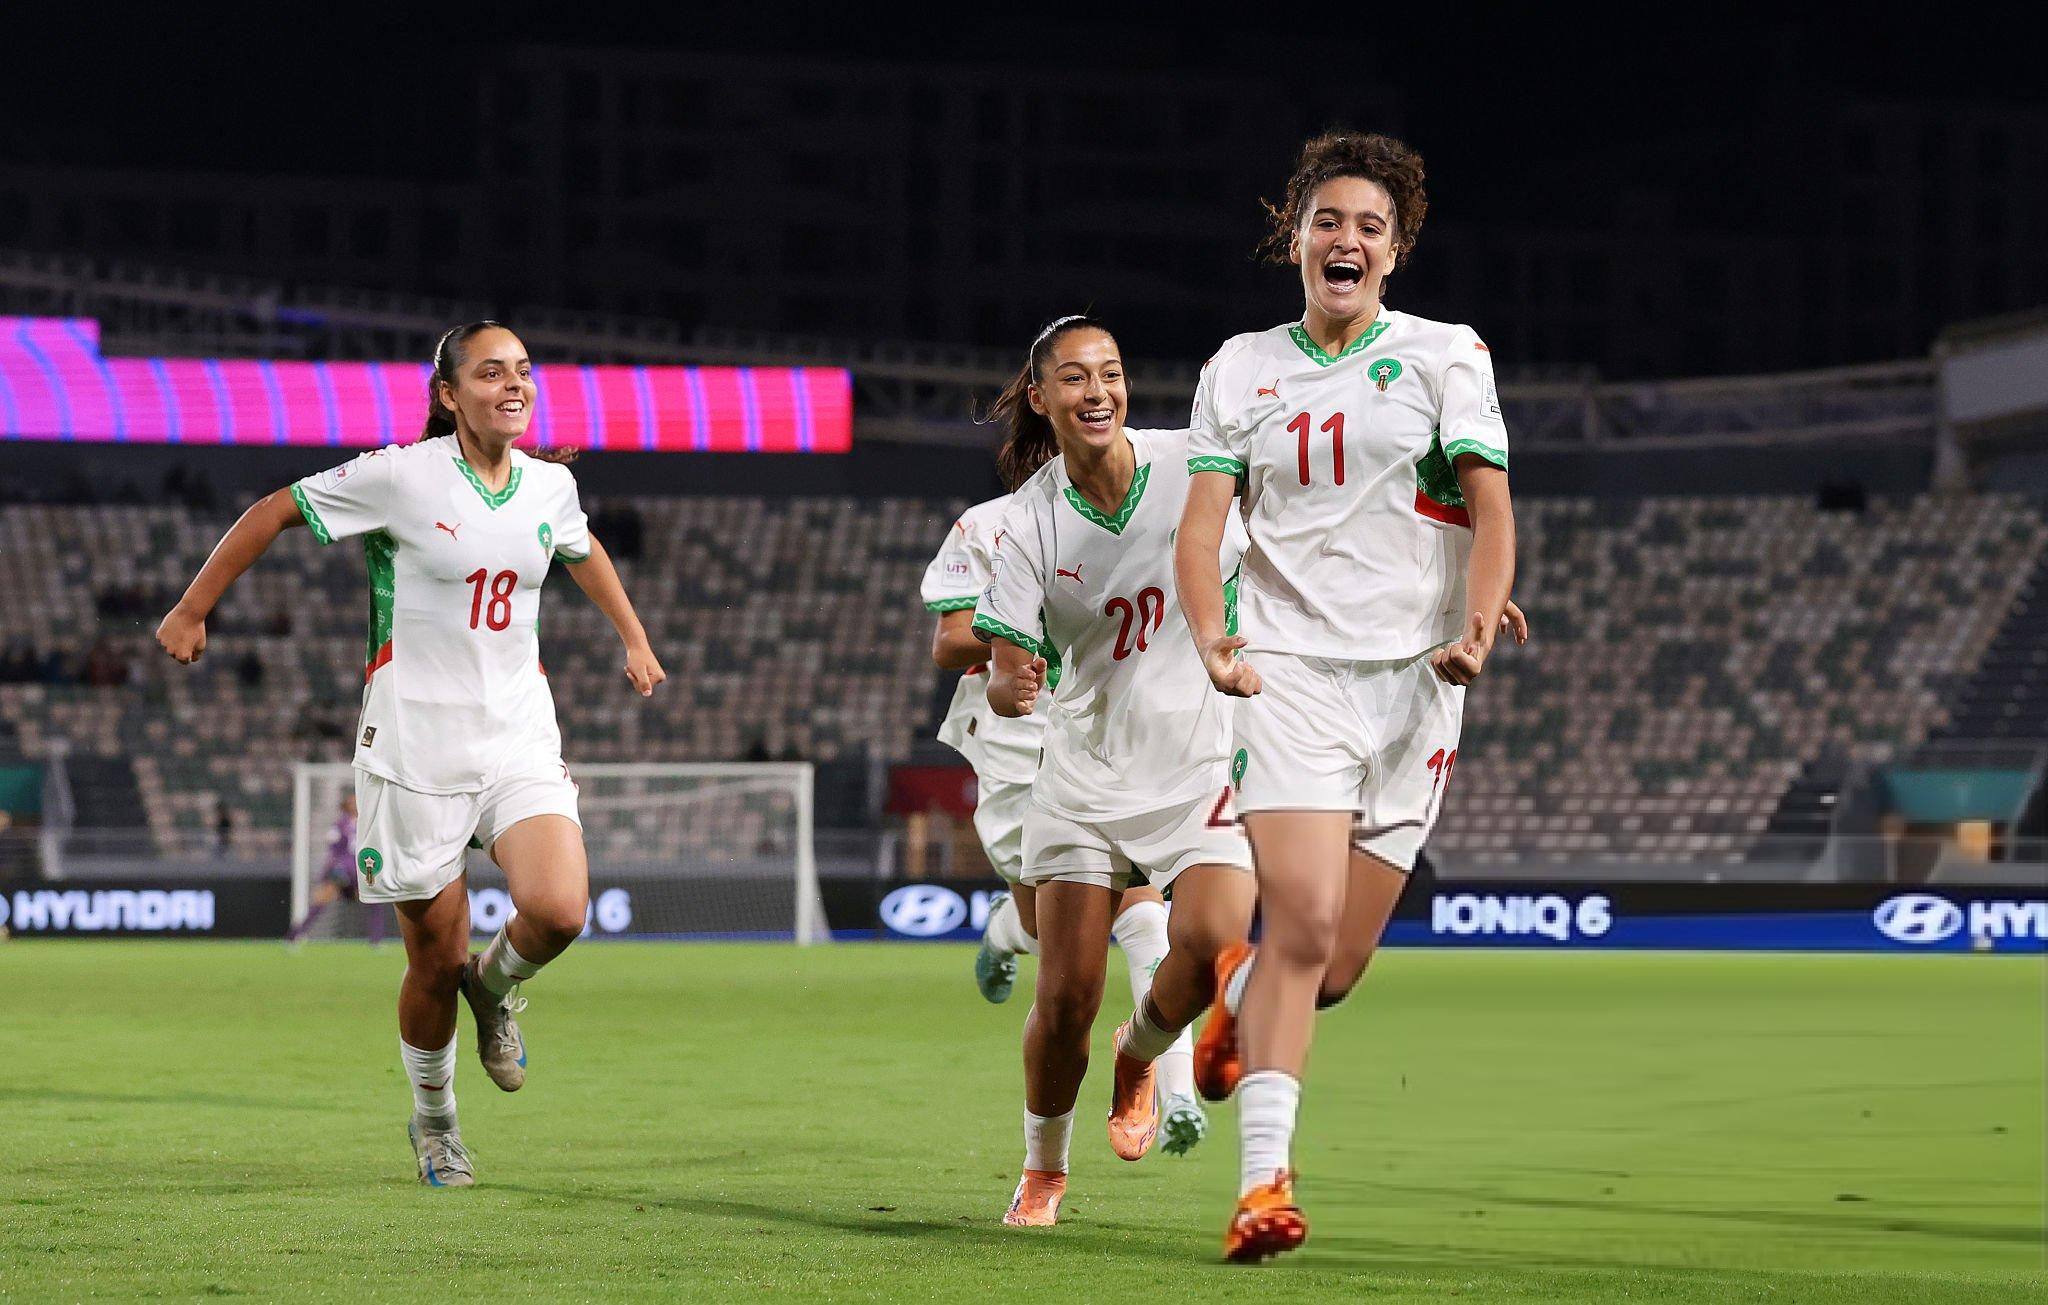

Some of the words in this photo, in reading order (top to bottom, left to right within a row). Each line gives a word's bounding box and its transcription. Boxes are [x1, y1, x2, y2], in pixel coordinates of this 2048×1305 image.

[1286, 411, 1345, 486] 11
[465, 567, 518, 631] 18
[1104, 586, 1165, 661] 20
[13, 889, 215, 931] HYUNDAI
[596, 887, 632, 933] 6
[1432, 893, 1571, 941] IONIQ
[1575, 895, 1613, 936] 6
